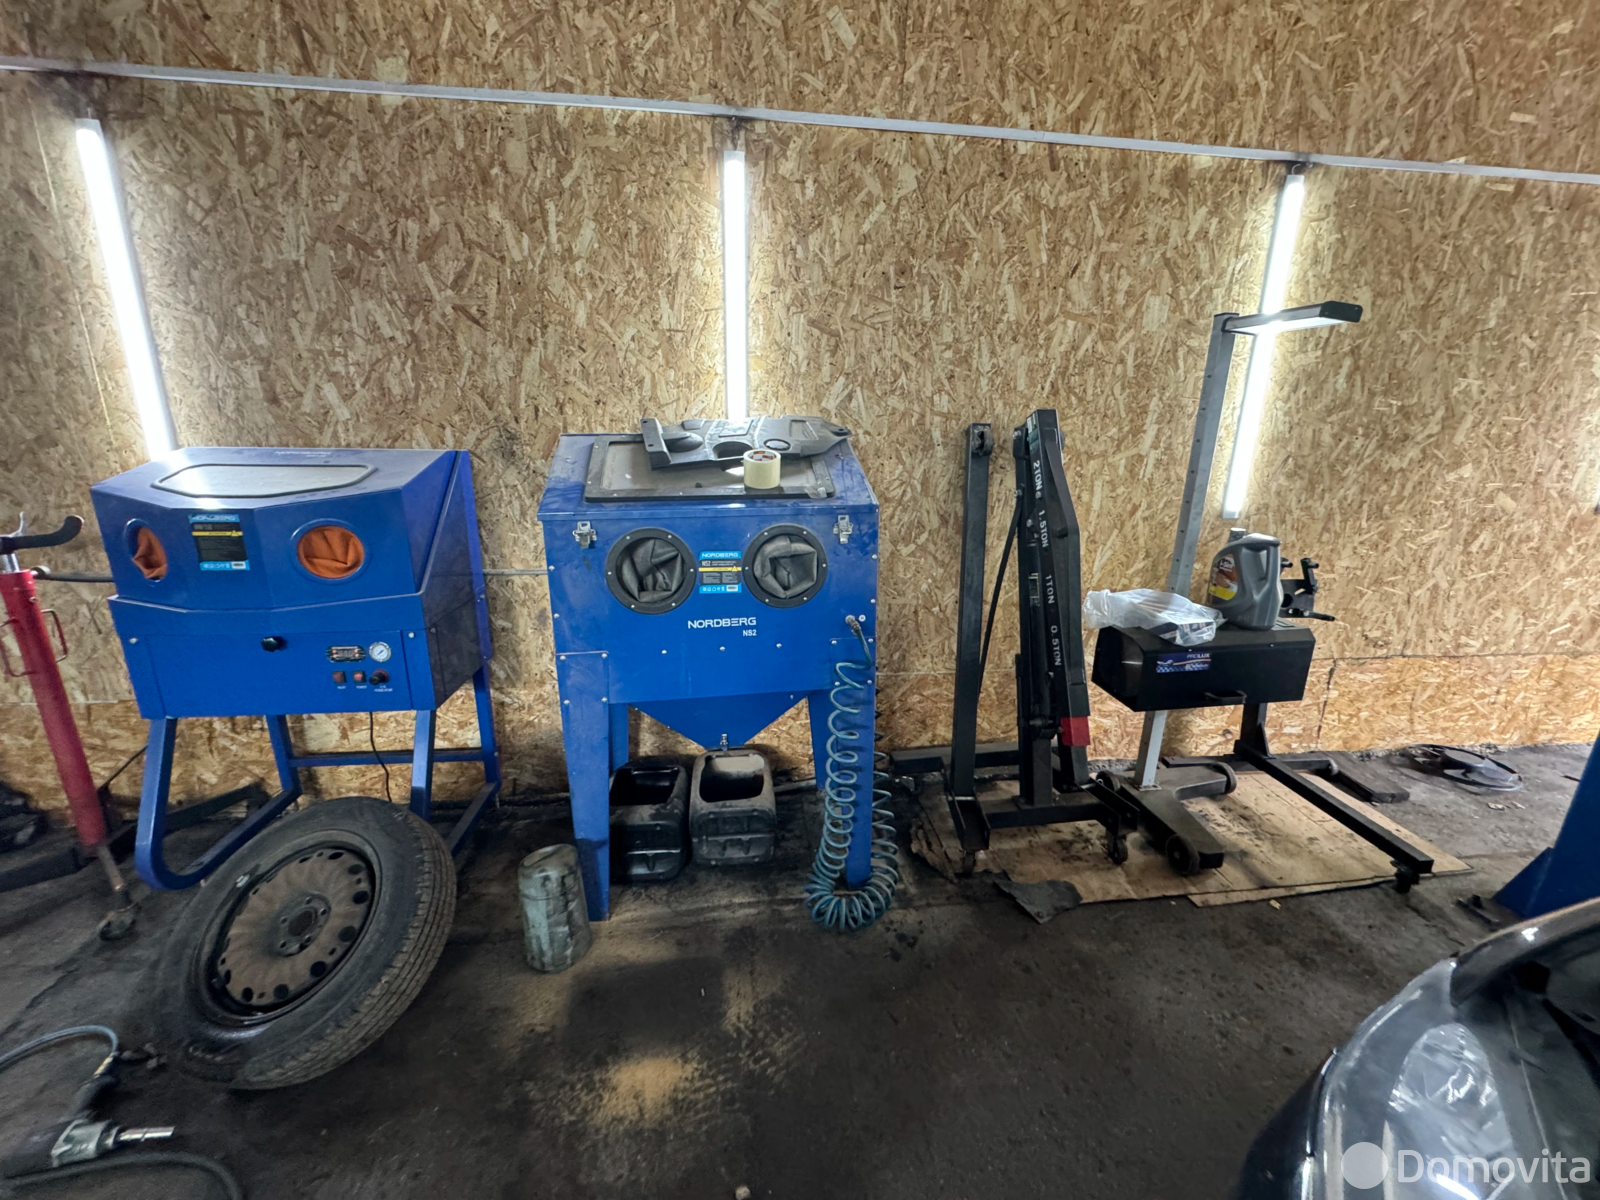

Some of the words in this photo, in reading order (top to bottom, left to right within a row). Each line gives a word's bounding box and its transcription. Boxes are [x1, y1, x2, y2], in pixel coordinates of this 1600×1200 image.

[1033, 460, 1043, 490] 2TON
[1038, 509, 1049, 547] 1.5TON
[1045, 574, 1055, 604] 1TON
[687, 616, 757, 629] NORDBERG
[742, 629, 757, 637] NS2
[1050, 625, 1062, 666] 0.5TON
